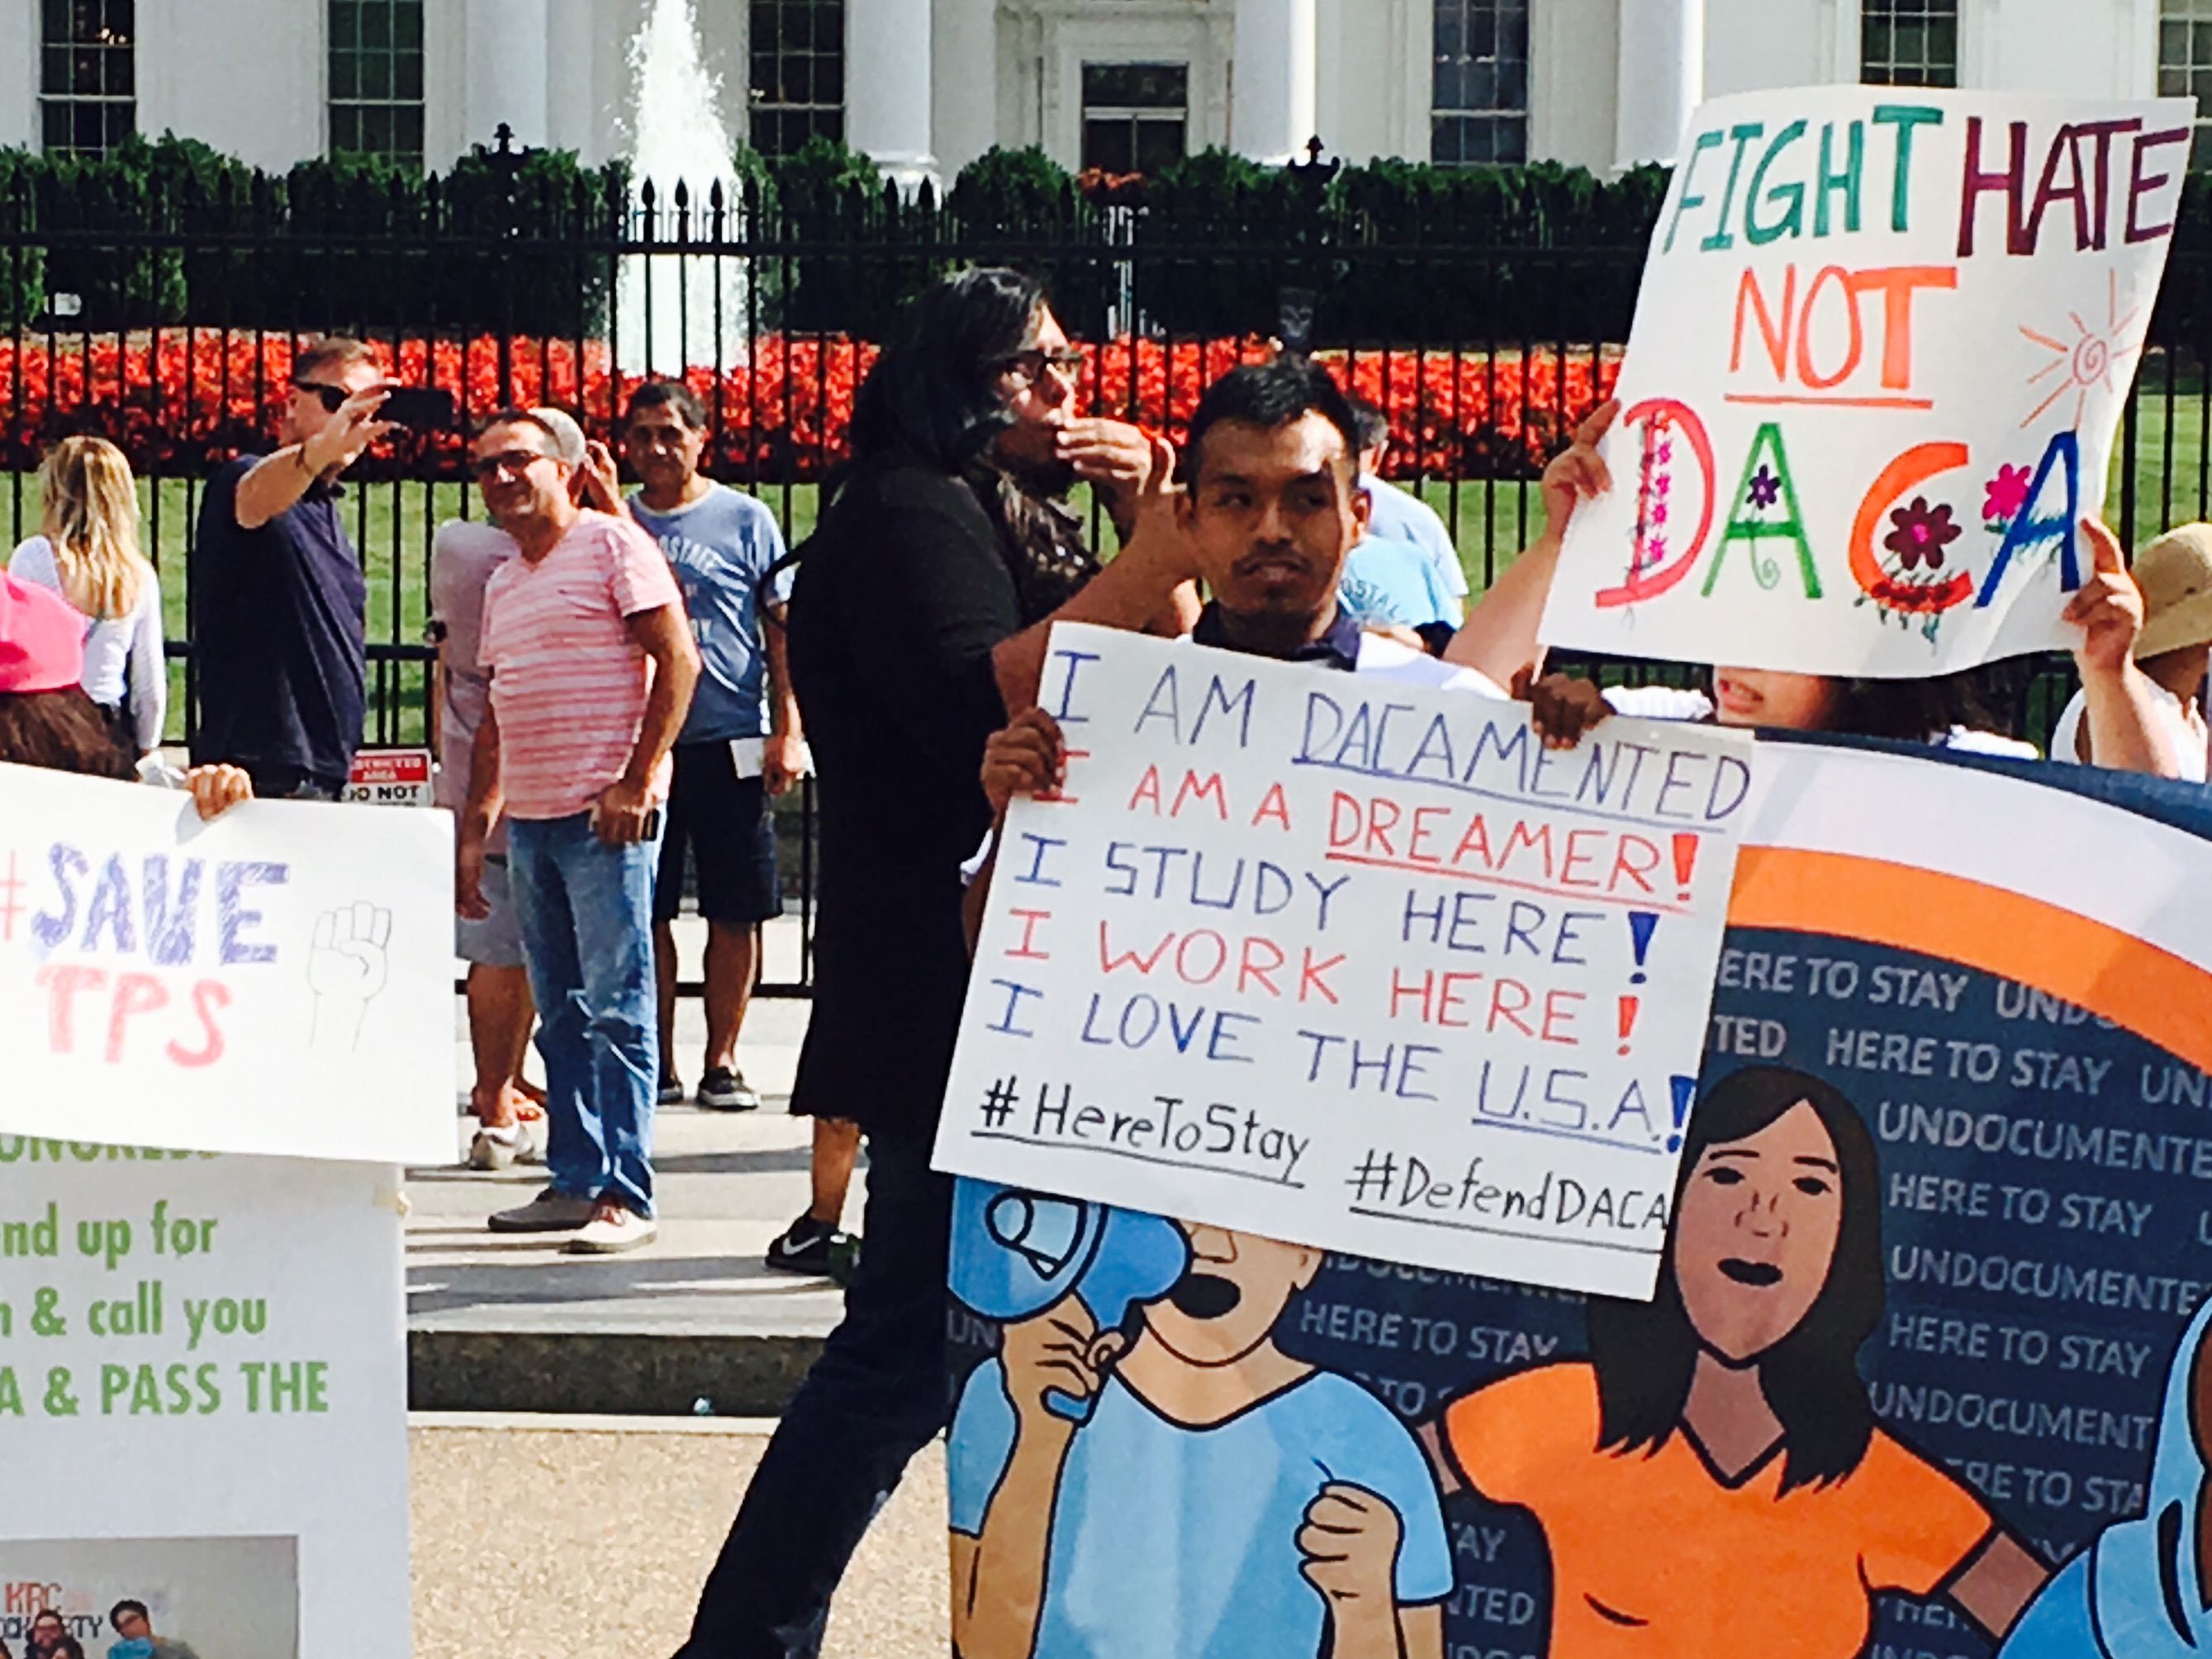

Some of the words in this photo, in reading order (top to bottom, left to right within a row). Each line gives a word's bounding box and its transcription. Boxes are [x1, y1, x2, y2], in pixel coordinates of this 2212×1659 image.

[1664, 105, 1943, 254] FIGHT
[1957, 117, 2188, 257] HATE
[1730, 263, 1957, 390] NOT
[1594, 399, 2080, 613] DACA
[1054, 651, 1100, 722] I
[1134, 664, 1256, 747] AM
[1304, 692, 1749, 820] DACAMENTED
[377, 785, 420, 799] NOT
[1128, 765, 1227, 820] AM
[1252, 782, 1290, 831] A
[1331, 791, 1698, 900] DREAMER!
[1014, 832, 1066, 886] I
[1104, 841, 1350, 929] STUDY
[1005, 908, 1051, 958] I
[1100, 920, 1346, 1003] WORK
[1806, 957, 1858, 999] TO
[1868, 965, 1968, 1012] STAY
[36, 964, 234, 1069] TPS
[986, 979, 1044, 1037] I
[1082, 993, 1261, 1062] LOVE
[1298, 1030, 1442, 1101] THE
[1714, 1014, 1787, 1057] TED
[1826, 1027, 1938, 1076] HERE
[1945, 1040, 2000, 1082] TO
[2010, 1048, 2112, 1096] STAY
[980, 1075, 1309, 1183] #HereToStay
[1878, 1102, 2212, 1178] UNDOCUMENTE
[1345, 1149, 1668, 1230] #DefendDACA
[1888, 1172, 1991, 1217] HERE
[2000, 1186, 2050, 1224] TO
[2059, 1193, 2153, 1237] STAY
[1, 1202, 58, 1257] nd
[77, 1219, 131, 1270] up
[150, 1199, 218, 1254] for
[31, 1287, 67, 1336] &
[88, 1281, 162, 1337] call
[183, 1298, 266, 1351] you
[1891, 1245, 2212, 1315] UNDOCUMENTE
[1300, 1299, 1403, 1348] HERE
[1411, 1317, 1457, 1356] TO
[1466, 1325, 1559, 1363] STAY
[1889, 1312, 1991, 1359] HERE
[1999, 1327, 2048, 1366] TO
[2059, 1335, 2151, 1379] STAY
[0, 1366, 26, 1416] A
[44, 1366, 79, 1416] &
[102, 1362, 221, 1415] PASS
[240, 1362, 328, 1413] THE
[1868, 1381, 2154, 1451] UNDOCUMENT
[2023, 1467, 2072, 1507] TO
